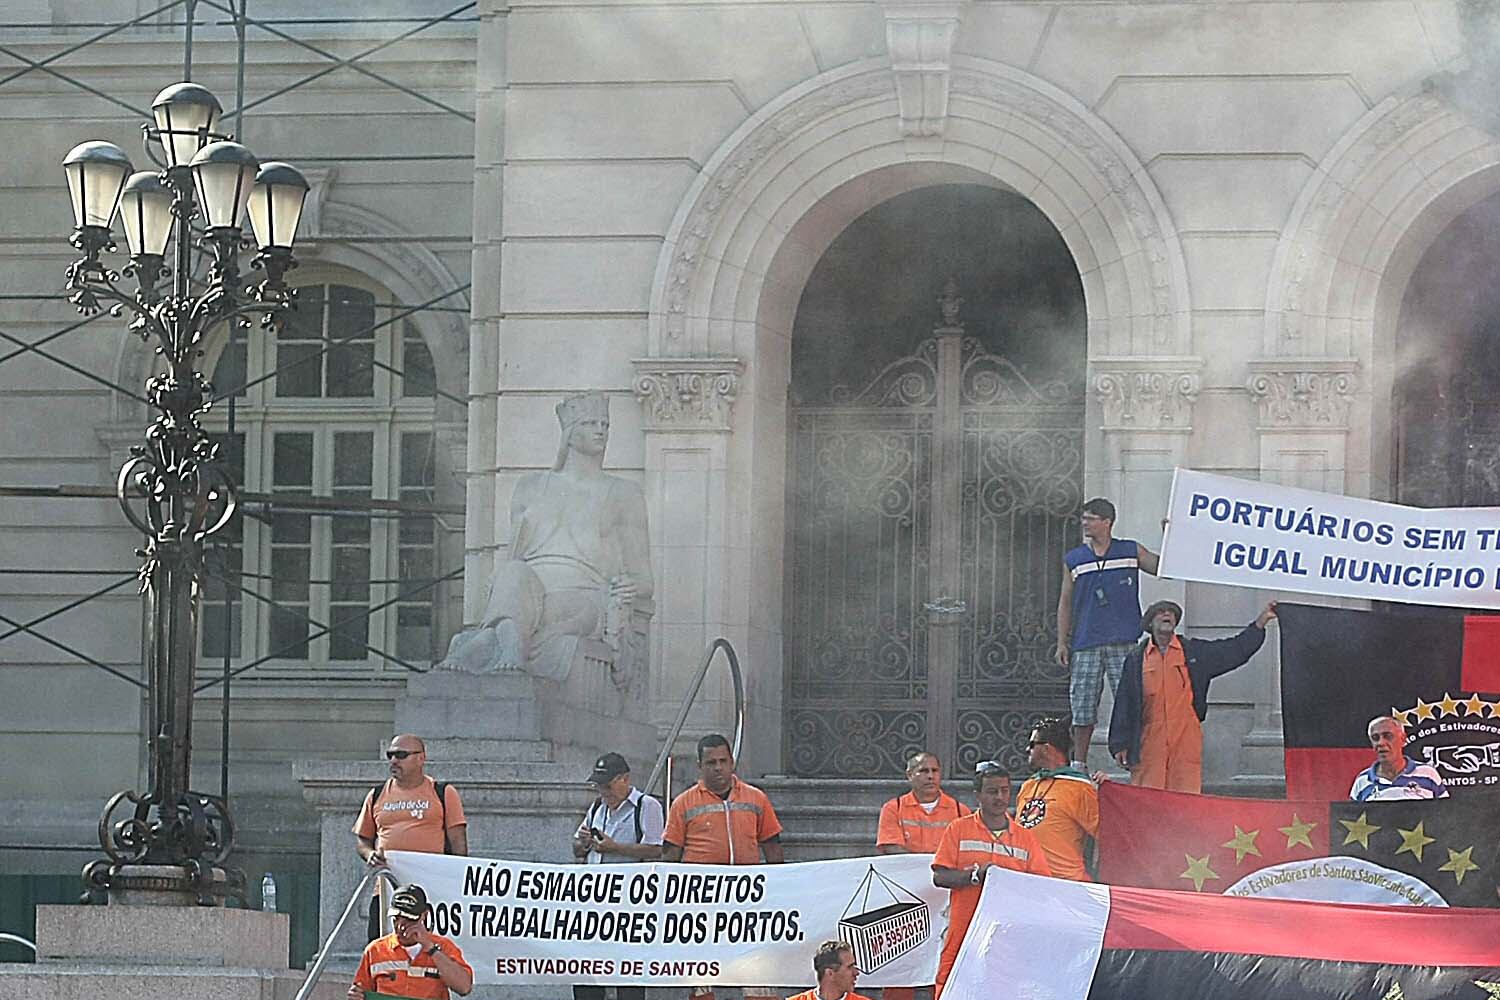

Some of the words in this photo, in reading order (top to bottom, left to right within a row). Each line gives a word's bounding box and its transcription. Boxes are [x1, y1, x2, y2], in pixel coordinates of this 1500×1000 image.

[1189, 493, 1394, 545] PORTUÁRIOS
[1403, 527, 1466, 550] SEM
[1213, 541, 1307, 575] IGUAL
[1321, 556, 1484, 588] MUNICÍPIO
[1418, 727, 1437, 738] dos
[1442, 777, 1475, 786] ANTOS
[1484, 776, 1498, 785] SP
[464, 862, 511, 897] NÃO
[516, 870, 624, 904] ESMAGUE
[629, 874, 659, 904] OS
[665, 874, 765, 904] DIREITOS
[1250, 866, 1307, 894] Estivadores
[1309, 864, 1322, 878] de
[469, 904, 657, 943] TRABALHADORES
[663, 912, 707, 944] DOS
[713, 910, 804, 944] PORTOS.
[870, 934, 884, 957] MP
[886, 919, 924, 947] 595/2012
[496, 958, 614, 975] ESTIVADORES
[620, 961, 643, 976] DE
[649, 961, 720, 976] SANTOS
